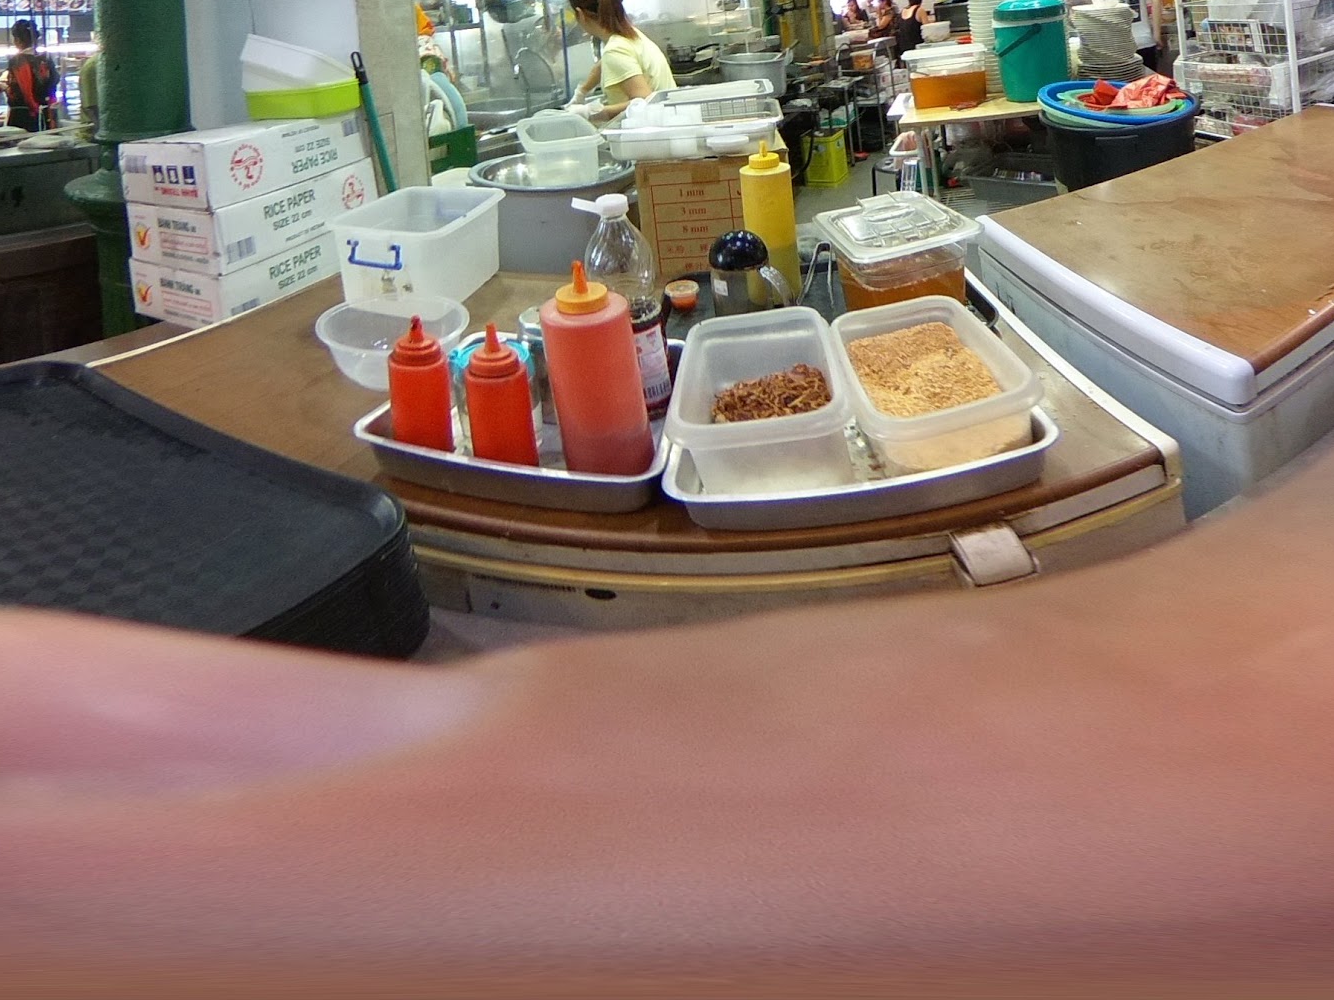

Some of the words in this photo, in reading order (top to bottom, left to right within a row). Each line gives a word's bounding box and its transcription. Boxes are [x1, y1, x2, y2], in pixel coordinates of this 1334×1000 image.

[291, 153, 319, 174] PAPER
[319, 148, 338, 165] RICE
[687, 188, 705, 197] mm
[263, 199, 286, 220] RICE
[287, 189, 316, 211] PAPER
[688, 207, 707, 215] mm
[273, 216, 290, 231] SIZE
[291, 212, 300, 223] 22
[690, 225, 709, 233] mm
[269, 258, 291, 280] RICE
[292, 245, 321, 269] PAPER
[278, 275, 296, 290] SIZE
[297, 270, 306, 281] 22
